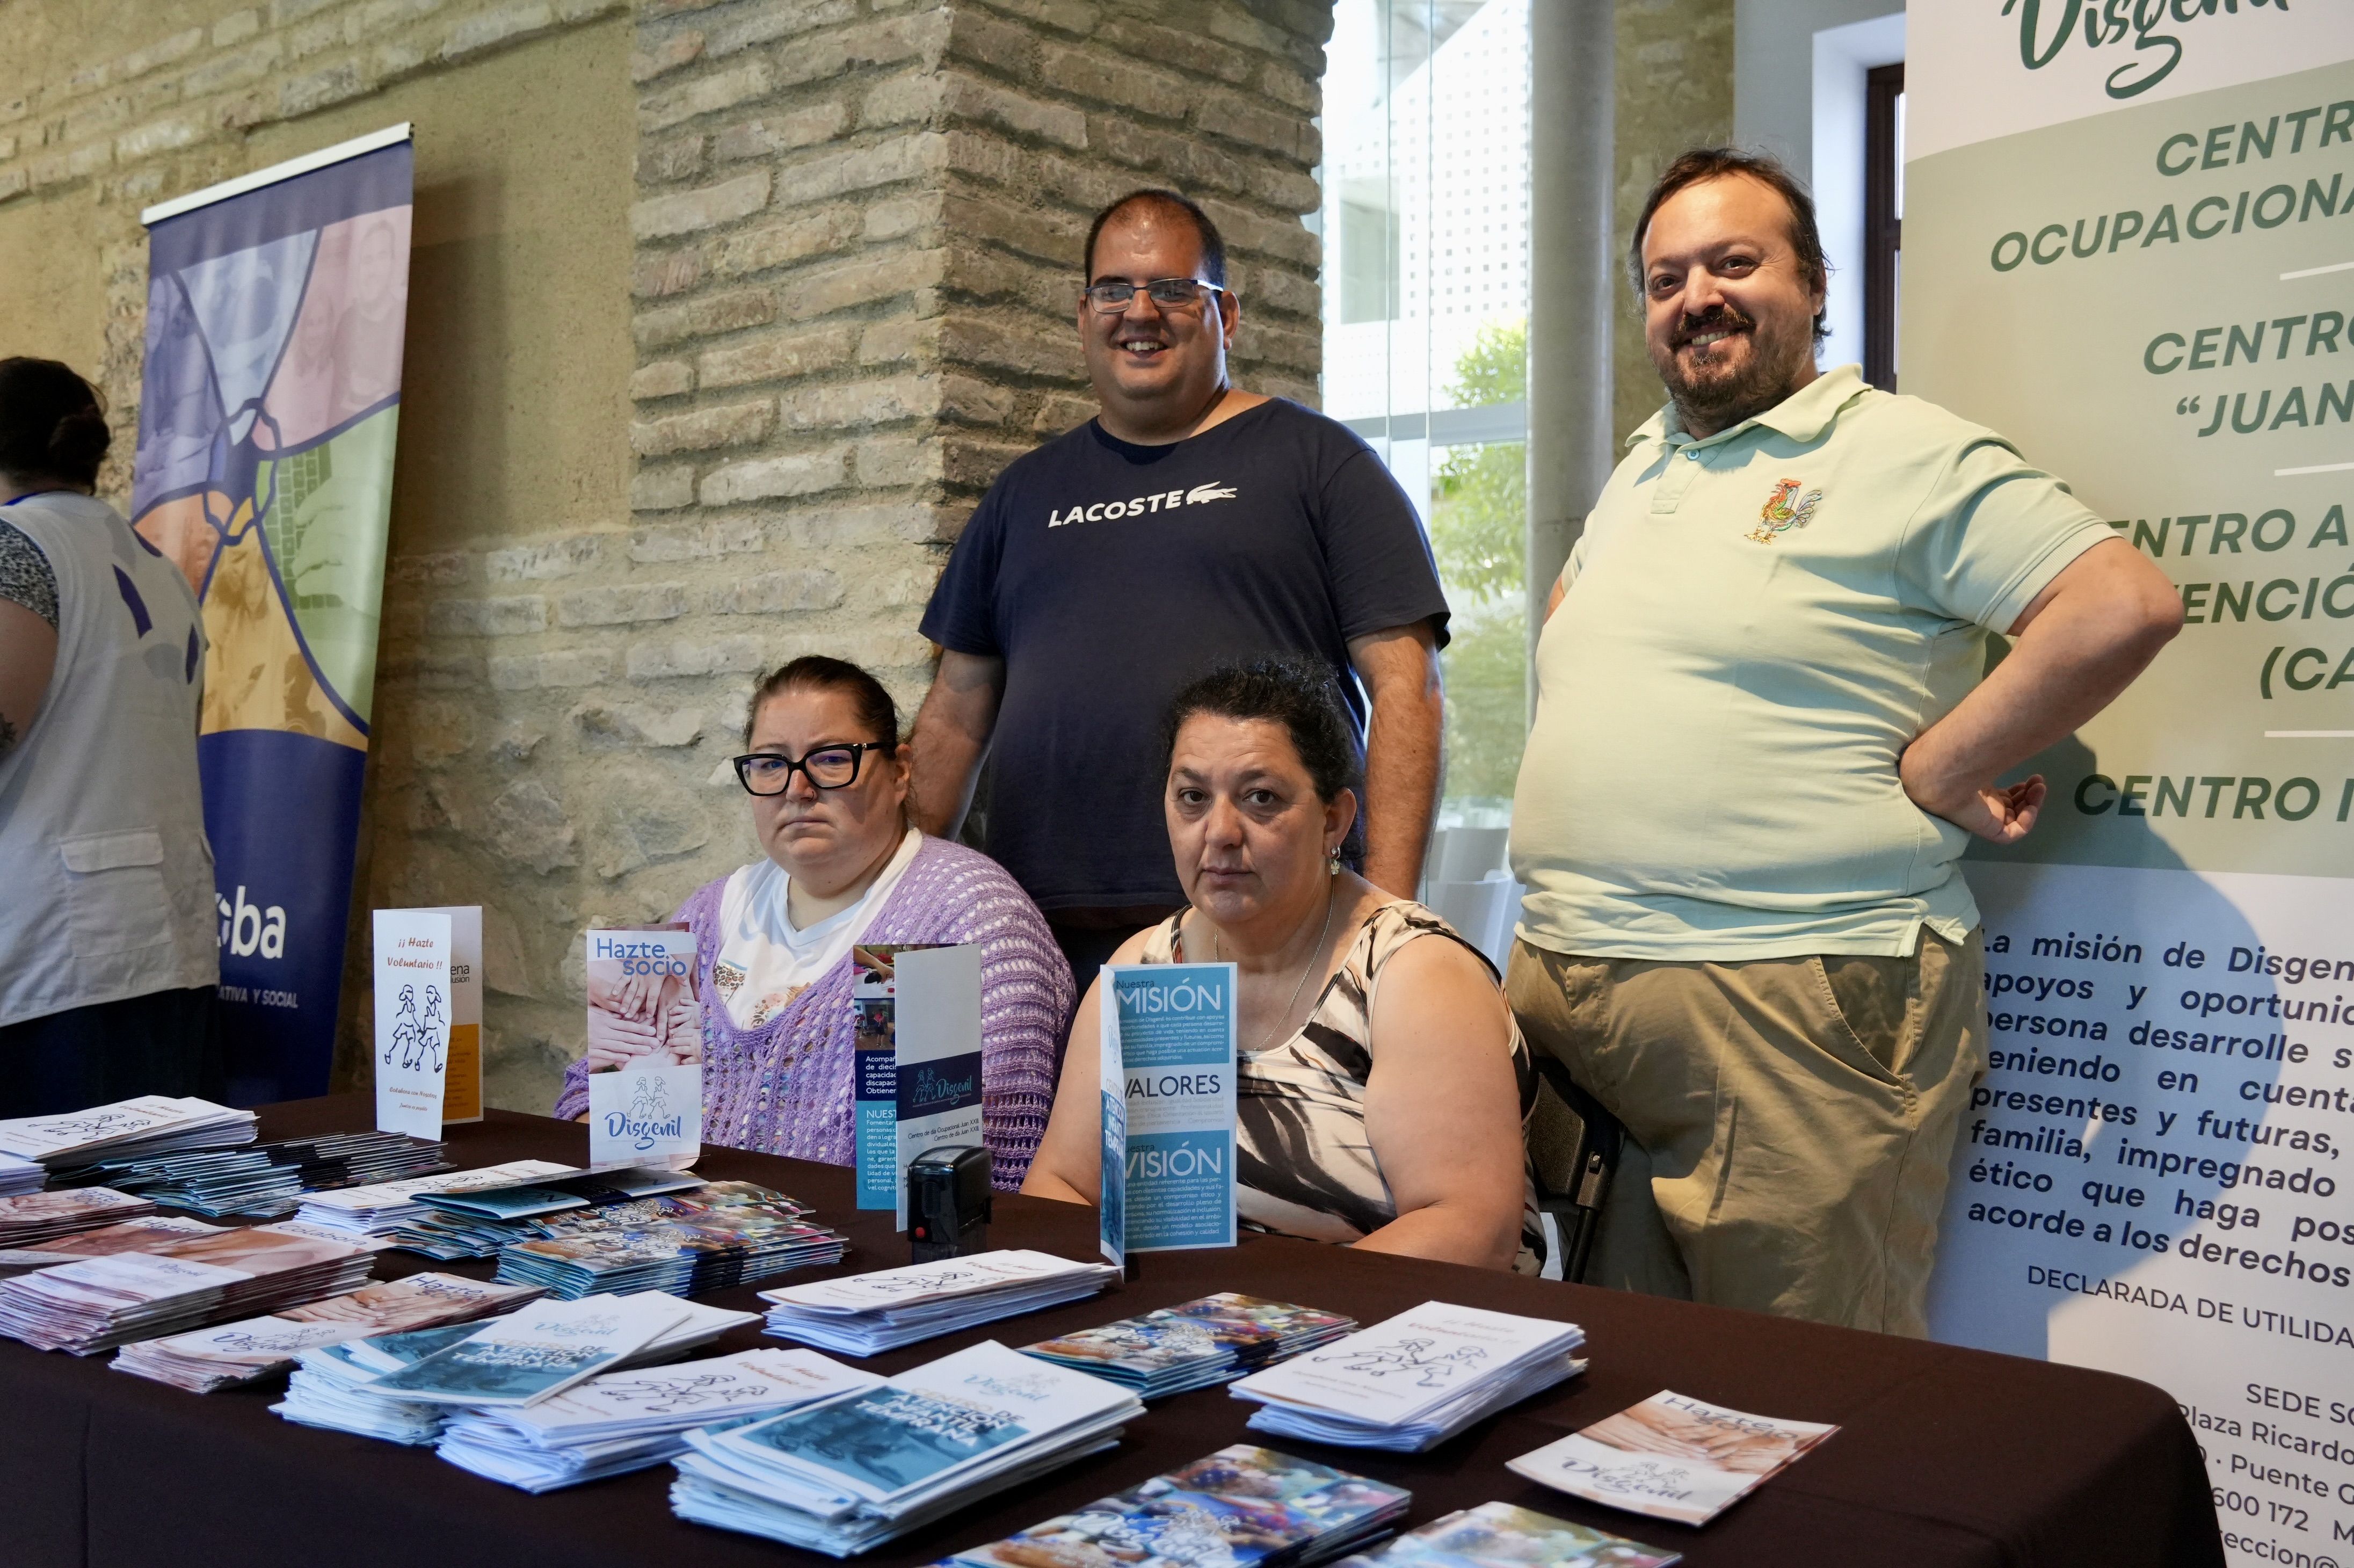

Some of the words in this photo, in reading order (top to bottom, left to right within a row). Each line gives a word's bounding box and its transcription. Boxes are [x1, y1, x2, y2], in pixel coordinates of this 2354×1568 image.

[2143, 310, 2354, 375] CENTR
[1048, 489, 1185, 528] LACOSTE
[2106, 509, 2296, 557] NTRO
[2174, 563, 2354, 624] ENCIÓ
[2073, 773, 2321, 822] CENTRO
[408, 937, 434, 948] Hazte
[597, 938, 666, 959] Hazte
[2031, 932, 2142, 964] misión
[2163, 941, 2205, 969] de
[387, 956, 434, 969] Voluntario
[622, 954, 687, 976] socio
[262, 990, 299, 1009] SOCIAL
[1116, 979, 1154, 989] Nuestra
[1116, 977, 1220, 1014] MISIÓN
[2125, 985, 2148, 1010] y
[1987, 1010, 2108, 1041] ersona
[2128, 1020, 2309, 1065] desarrolle
[866, 1079, 896, 1087] discapaci
[936, 1075, 972, 1106] Disgenil
[2157, 1070, 2198, 1094] en
[2239, 1080, 2354, 1114] cuent
[604, 1112, 681, 1150] Disgenil
[907, 1131, 924, 1139] Centro
[937, 1123, 960, 1133] Ocupacional
[1970, 1086, 2138, 1126] presentes
[2154, 1110, 2177, 1137] y
[2197, 1110, 2340, 1160] futuras,
[1970, 1120, 2091, 1164] familia,
[2117, 1138, 2336, 1197] impregnado
[1968, 1158, 2053, 1193] ético
[2081, 1180, 2146, 1208] que
[2174, 1189, 2261, 1231] haga
[278, 1224, 367, 1246] Colabora
[1967, 1201, 2086, 1237] acorde
[2093, 1223, 2112, 1244] a
[2120, 1221, 2170, 1253] los
[2178, 1233, 2351, 1288] derechos
[405, 1276, 483, 1295] Hazte
[2027, 1265, 2189, 1315] DECLARADA
[2197, 1297, 2234, 1324] DE
[1662, 1397, 1774, 1429] Hazte
[2246, 1383, 2321, 1418] SEDE
[2329, 1402, 2354, 1427] S
[1693, 1415, 1799, 1440] socio
[2251, 1421, 2354, 1465] Ricardo
[1560, 1455, 1696, 1502] Disgenil
[2230, 1453, 2329, 1498] Puente
[2267, 1501, 2309, 1531] 172
